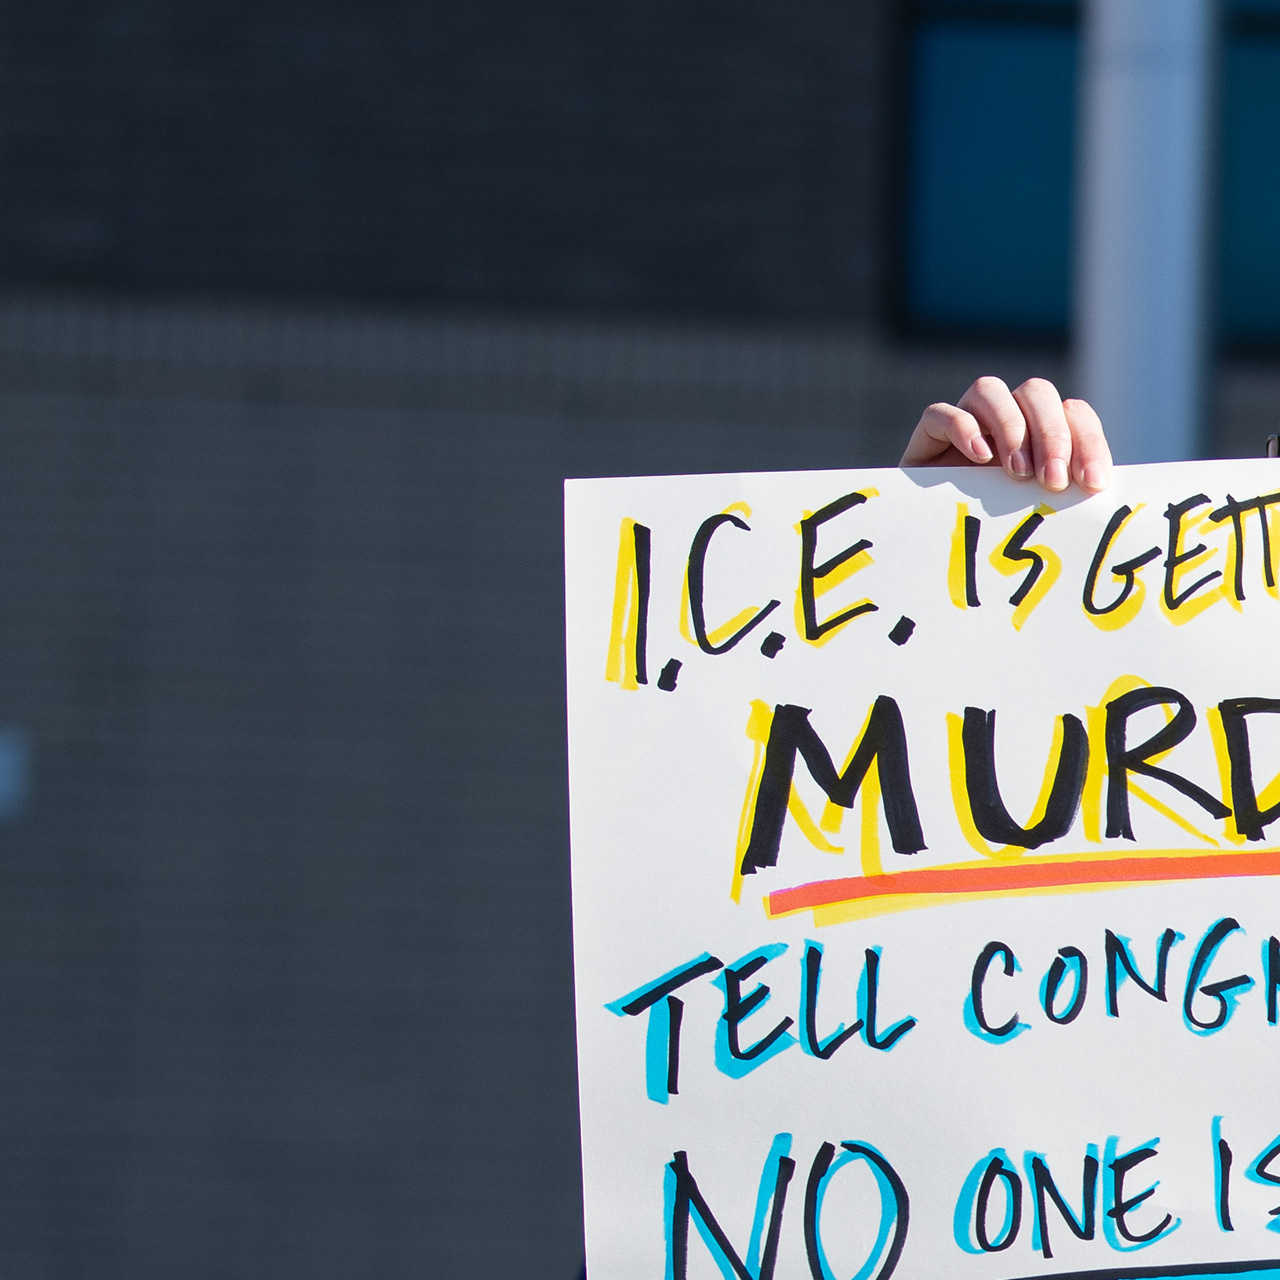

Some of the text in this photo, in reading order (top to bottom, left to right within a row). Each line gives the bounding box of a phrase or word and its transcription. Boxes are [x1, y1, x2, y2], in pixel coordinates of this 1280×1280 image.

[606, 487, 916, 692] I.C.E.
[947, 501, 1063, 632] IS
[603, 938, 919, 1105] TELL
[953, 1134, 1182, 1259] ONE
